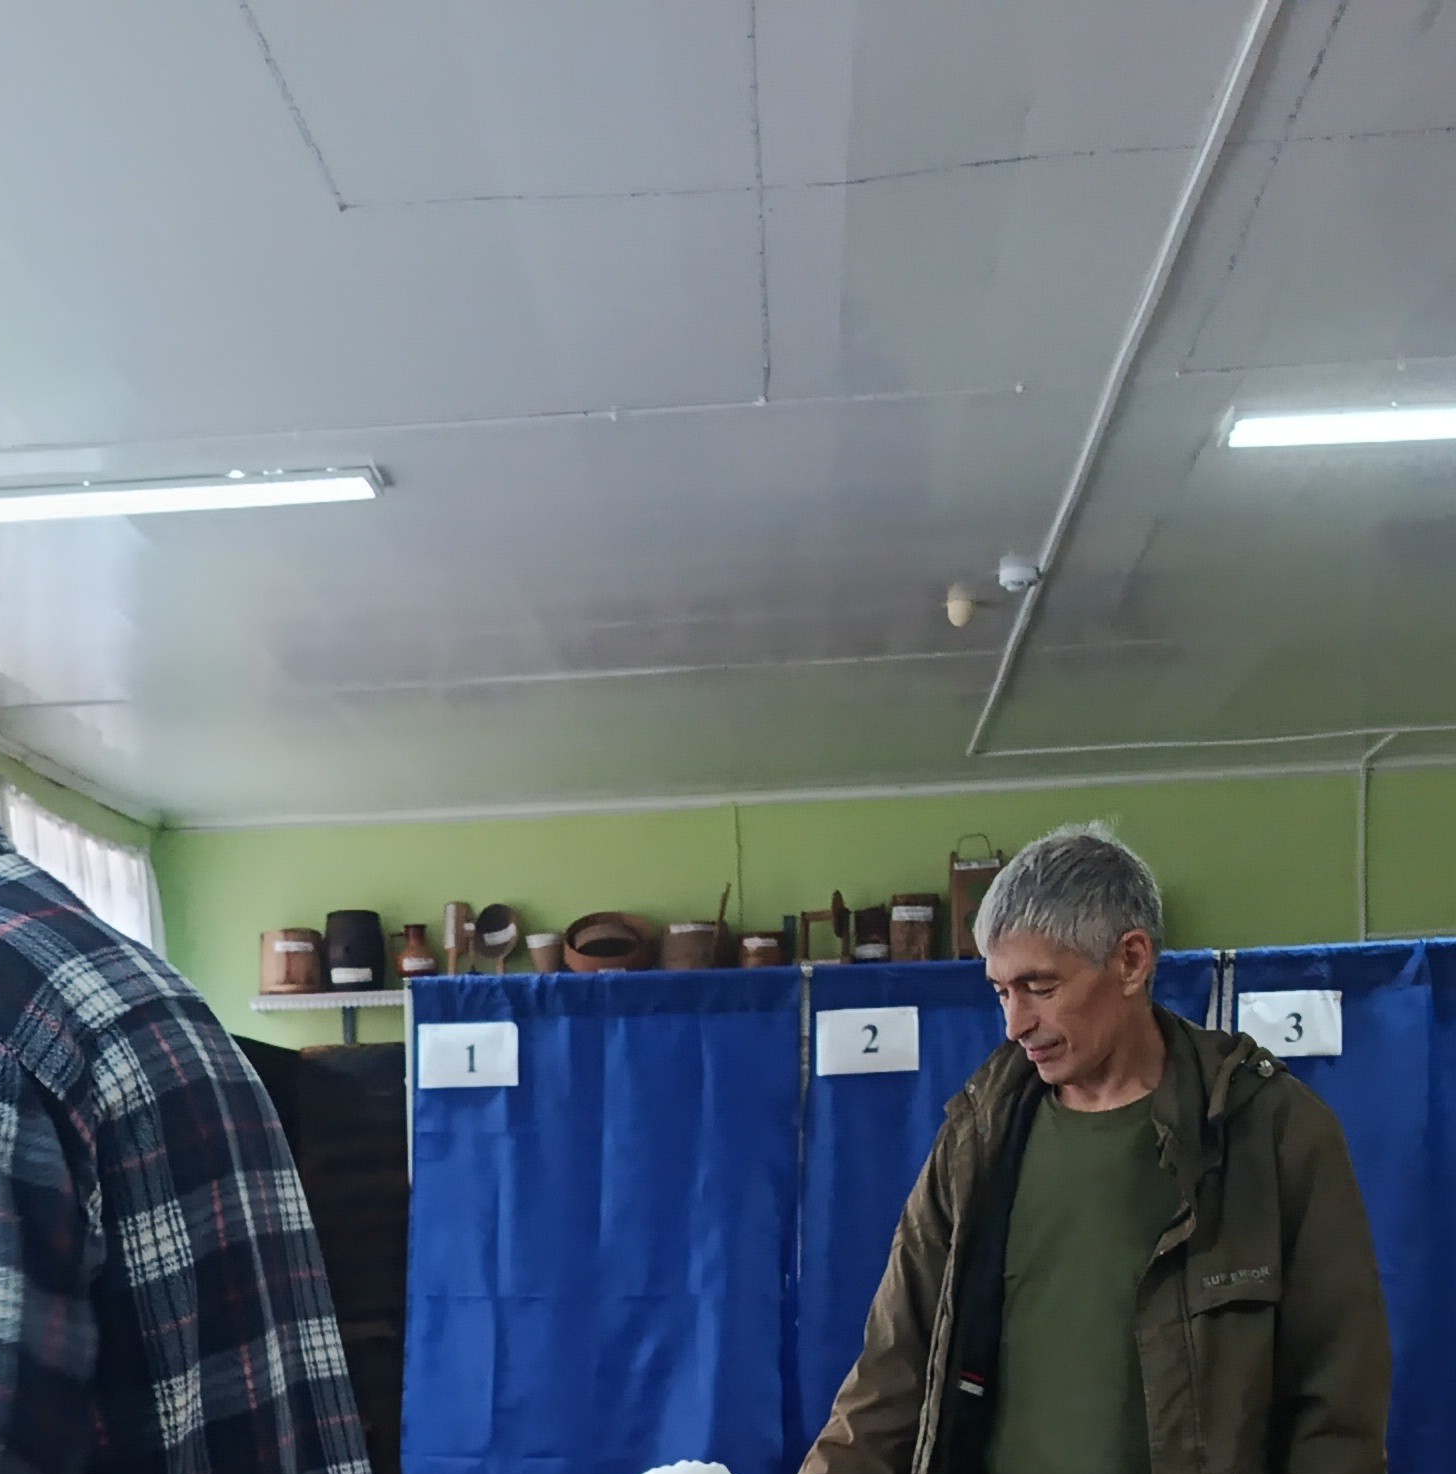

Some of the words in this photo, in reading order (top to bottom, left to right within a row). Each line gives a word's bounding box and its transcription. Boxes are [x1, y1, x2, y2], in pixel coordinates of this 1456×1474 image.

[862, 1024, 879, 1054] 2
[1284, 1012, 1303, 1043] 3
[466, 1044, 476, 1073] 1
